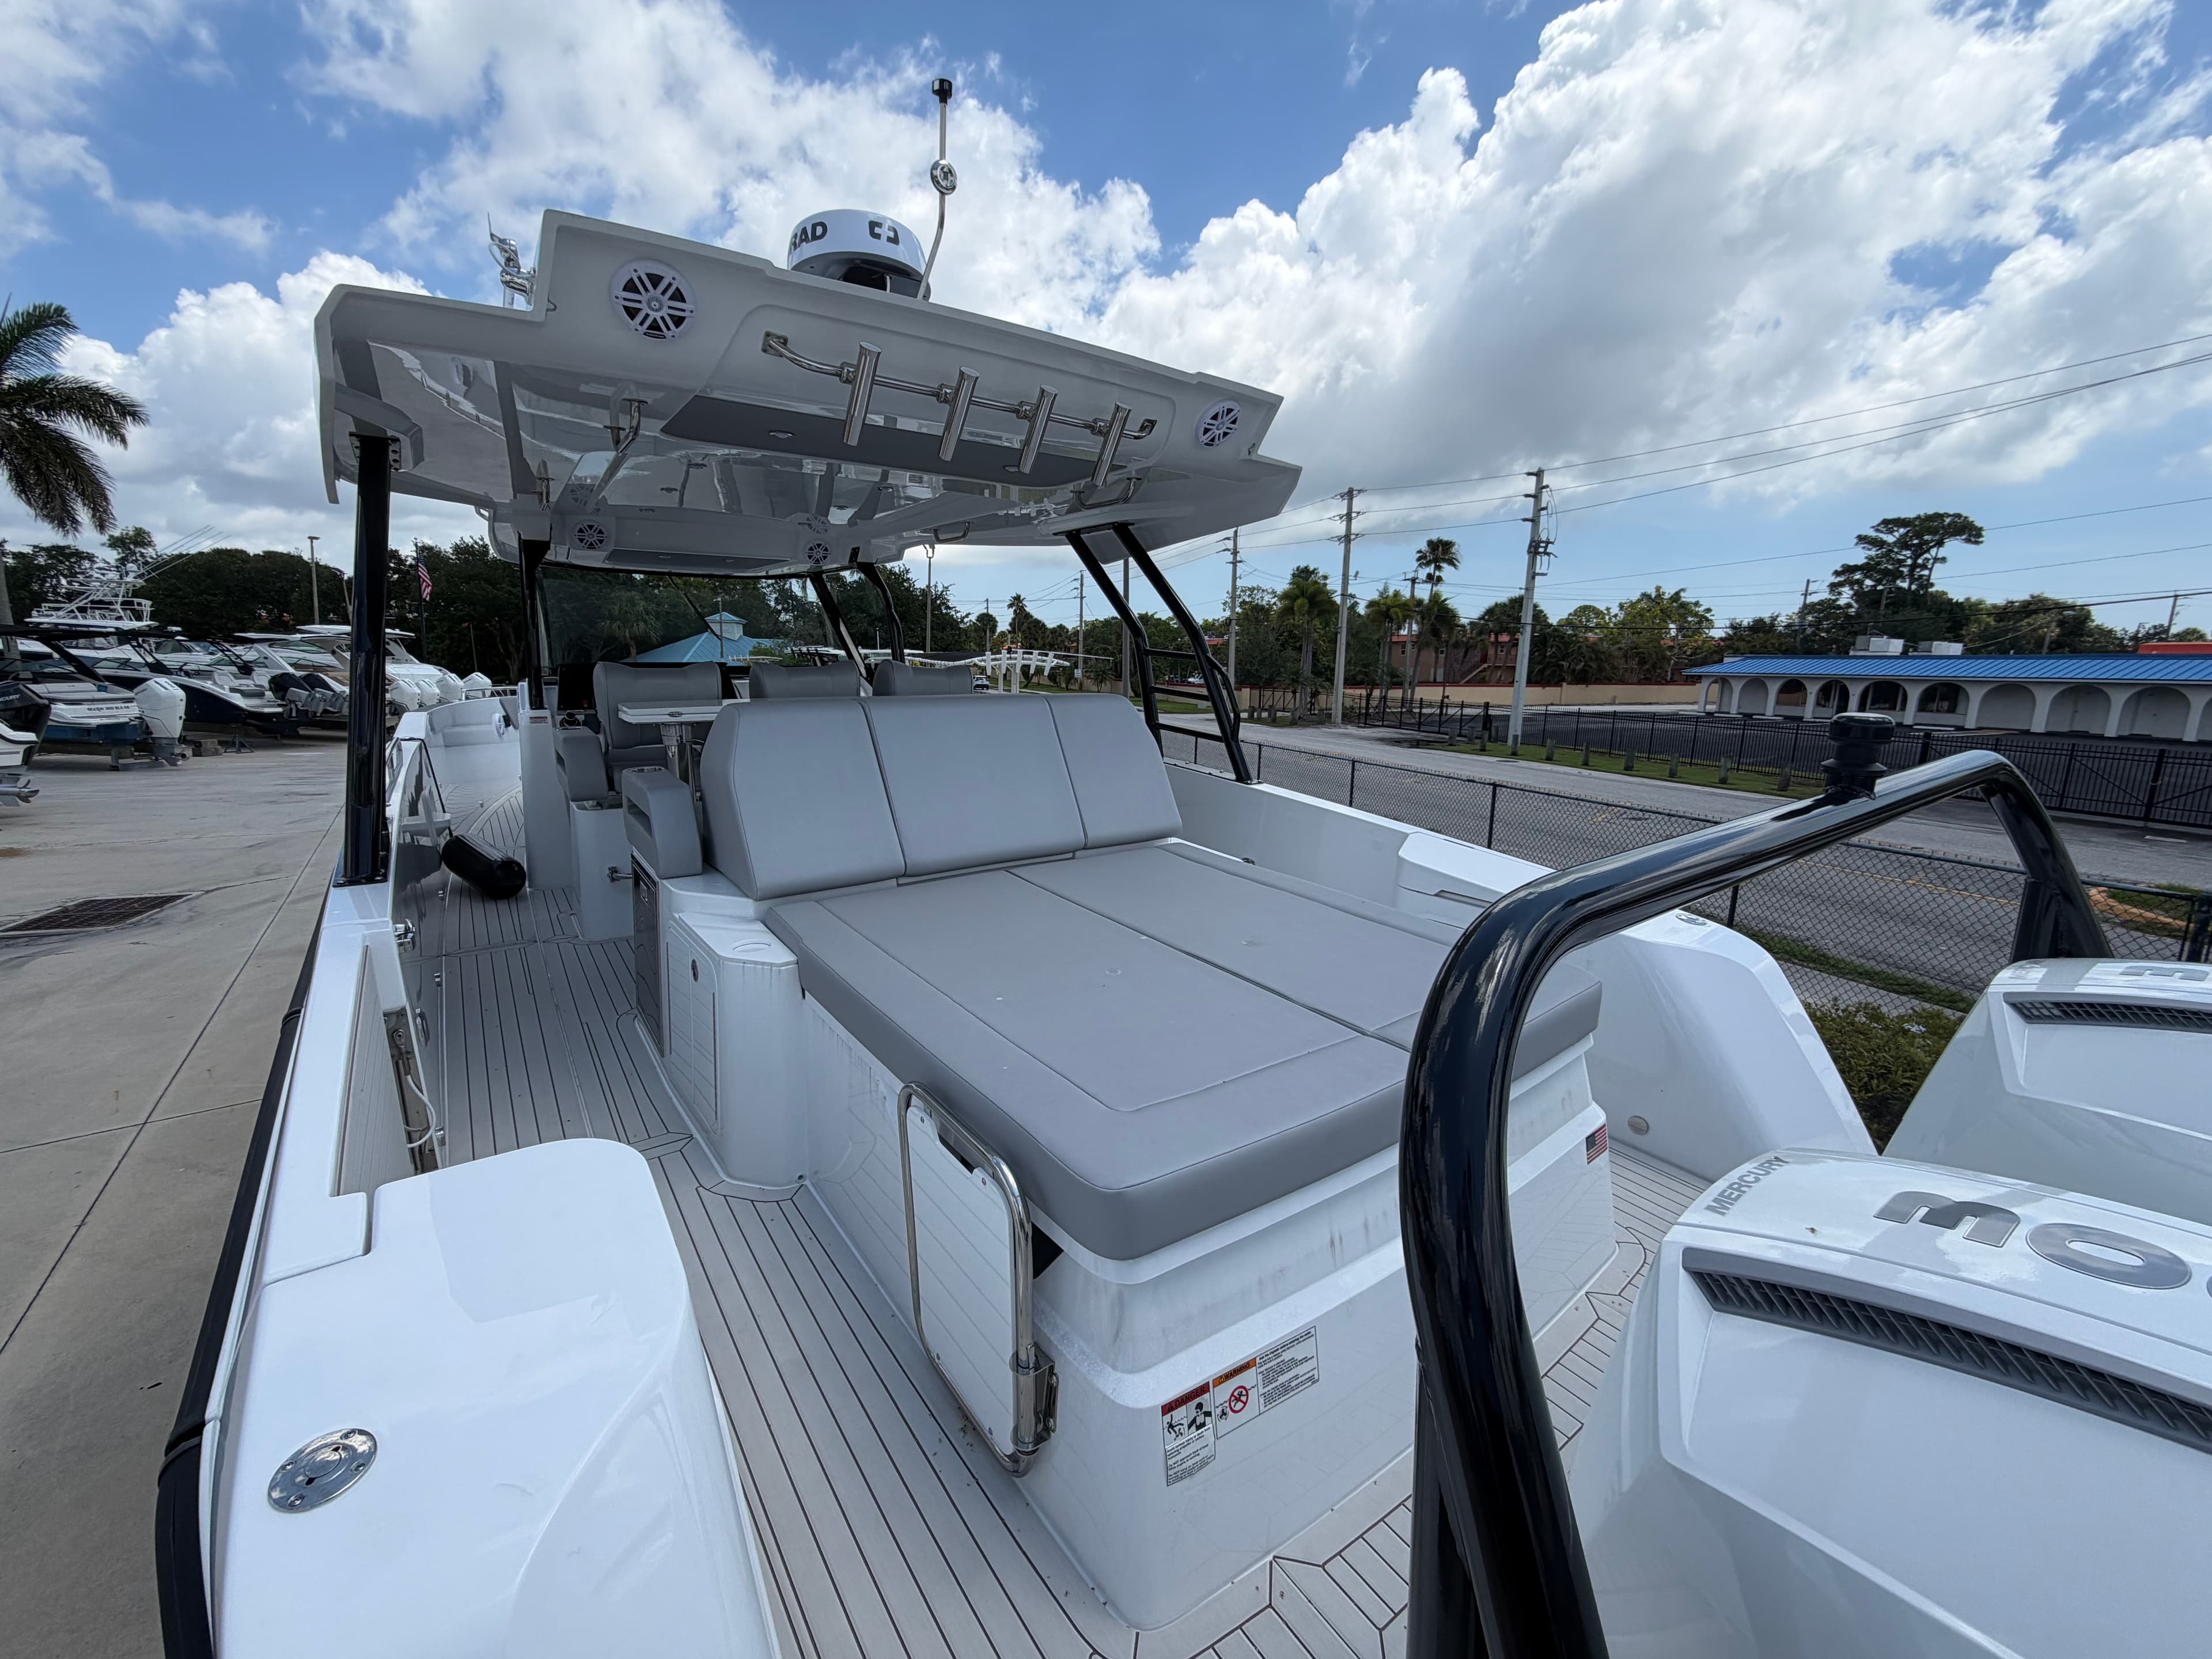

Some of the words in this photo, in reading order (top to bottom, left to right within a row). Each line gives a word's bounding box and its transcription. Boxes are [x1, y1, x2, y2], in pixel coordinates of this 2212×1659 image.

[1703, 1156, 1790, 1217] MERCURY
[1224, 1362, 1250, 1381] WARNING
[1175, 1386, 1206, 1407] DANGER
